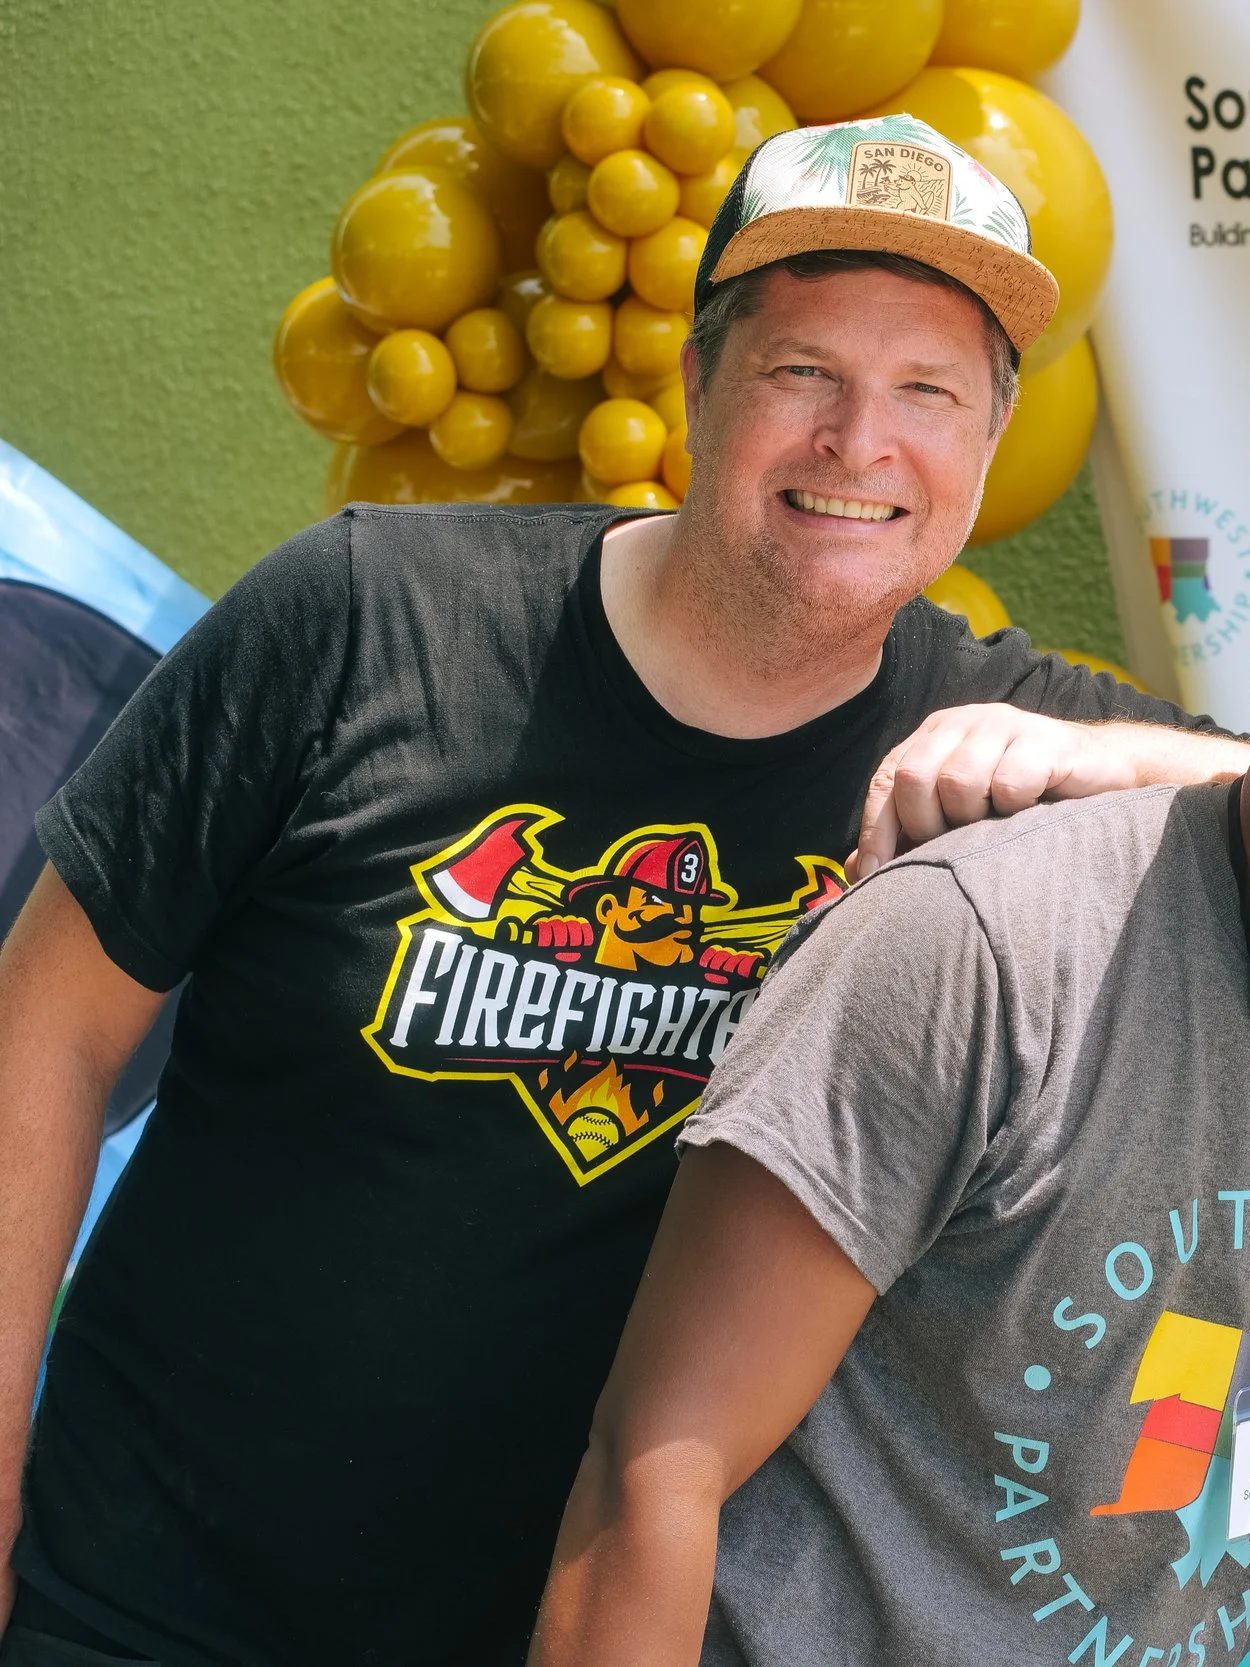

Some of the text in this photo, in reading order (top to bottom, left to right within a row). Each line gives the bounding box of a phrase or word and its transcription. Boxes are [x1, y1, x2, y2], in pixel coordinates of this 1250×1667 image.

[863, 147, 944, 173] SAN DIEGO
[681, 853, 698, 883] 3
[389, 928, 760, 1067] FIREFIGHTE
